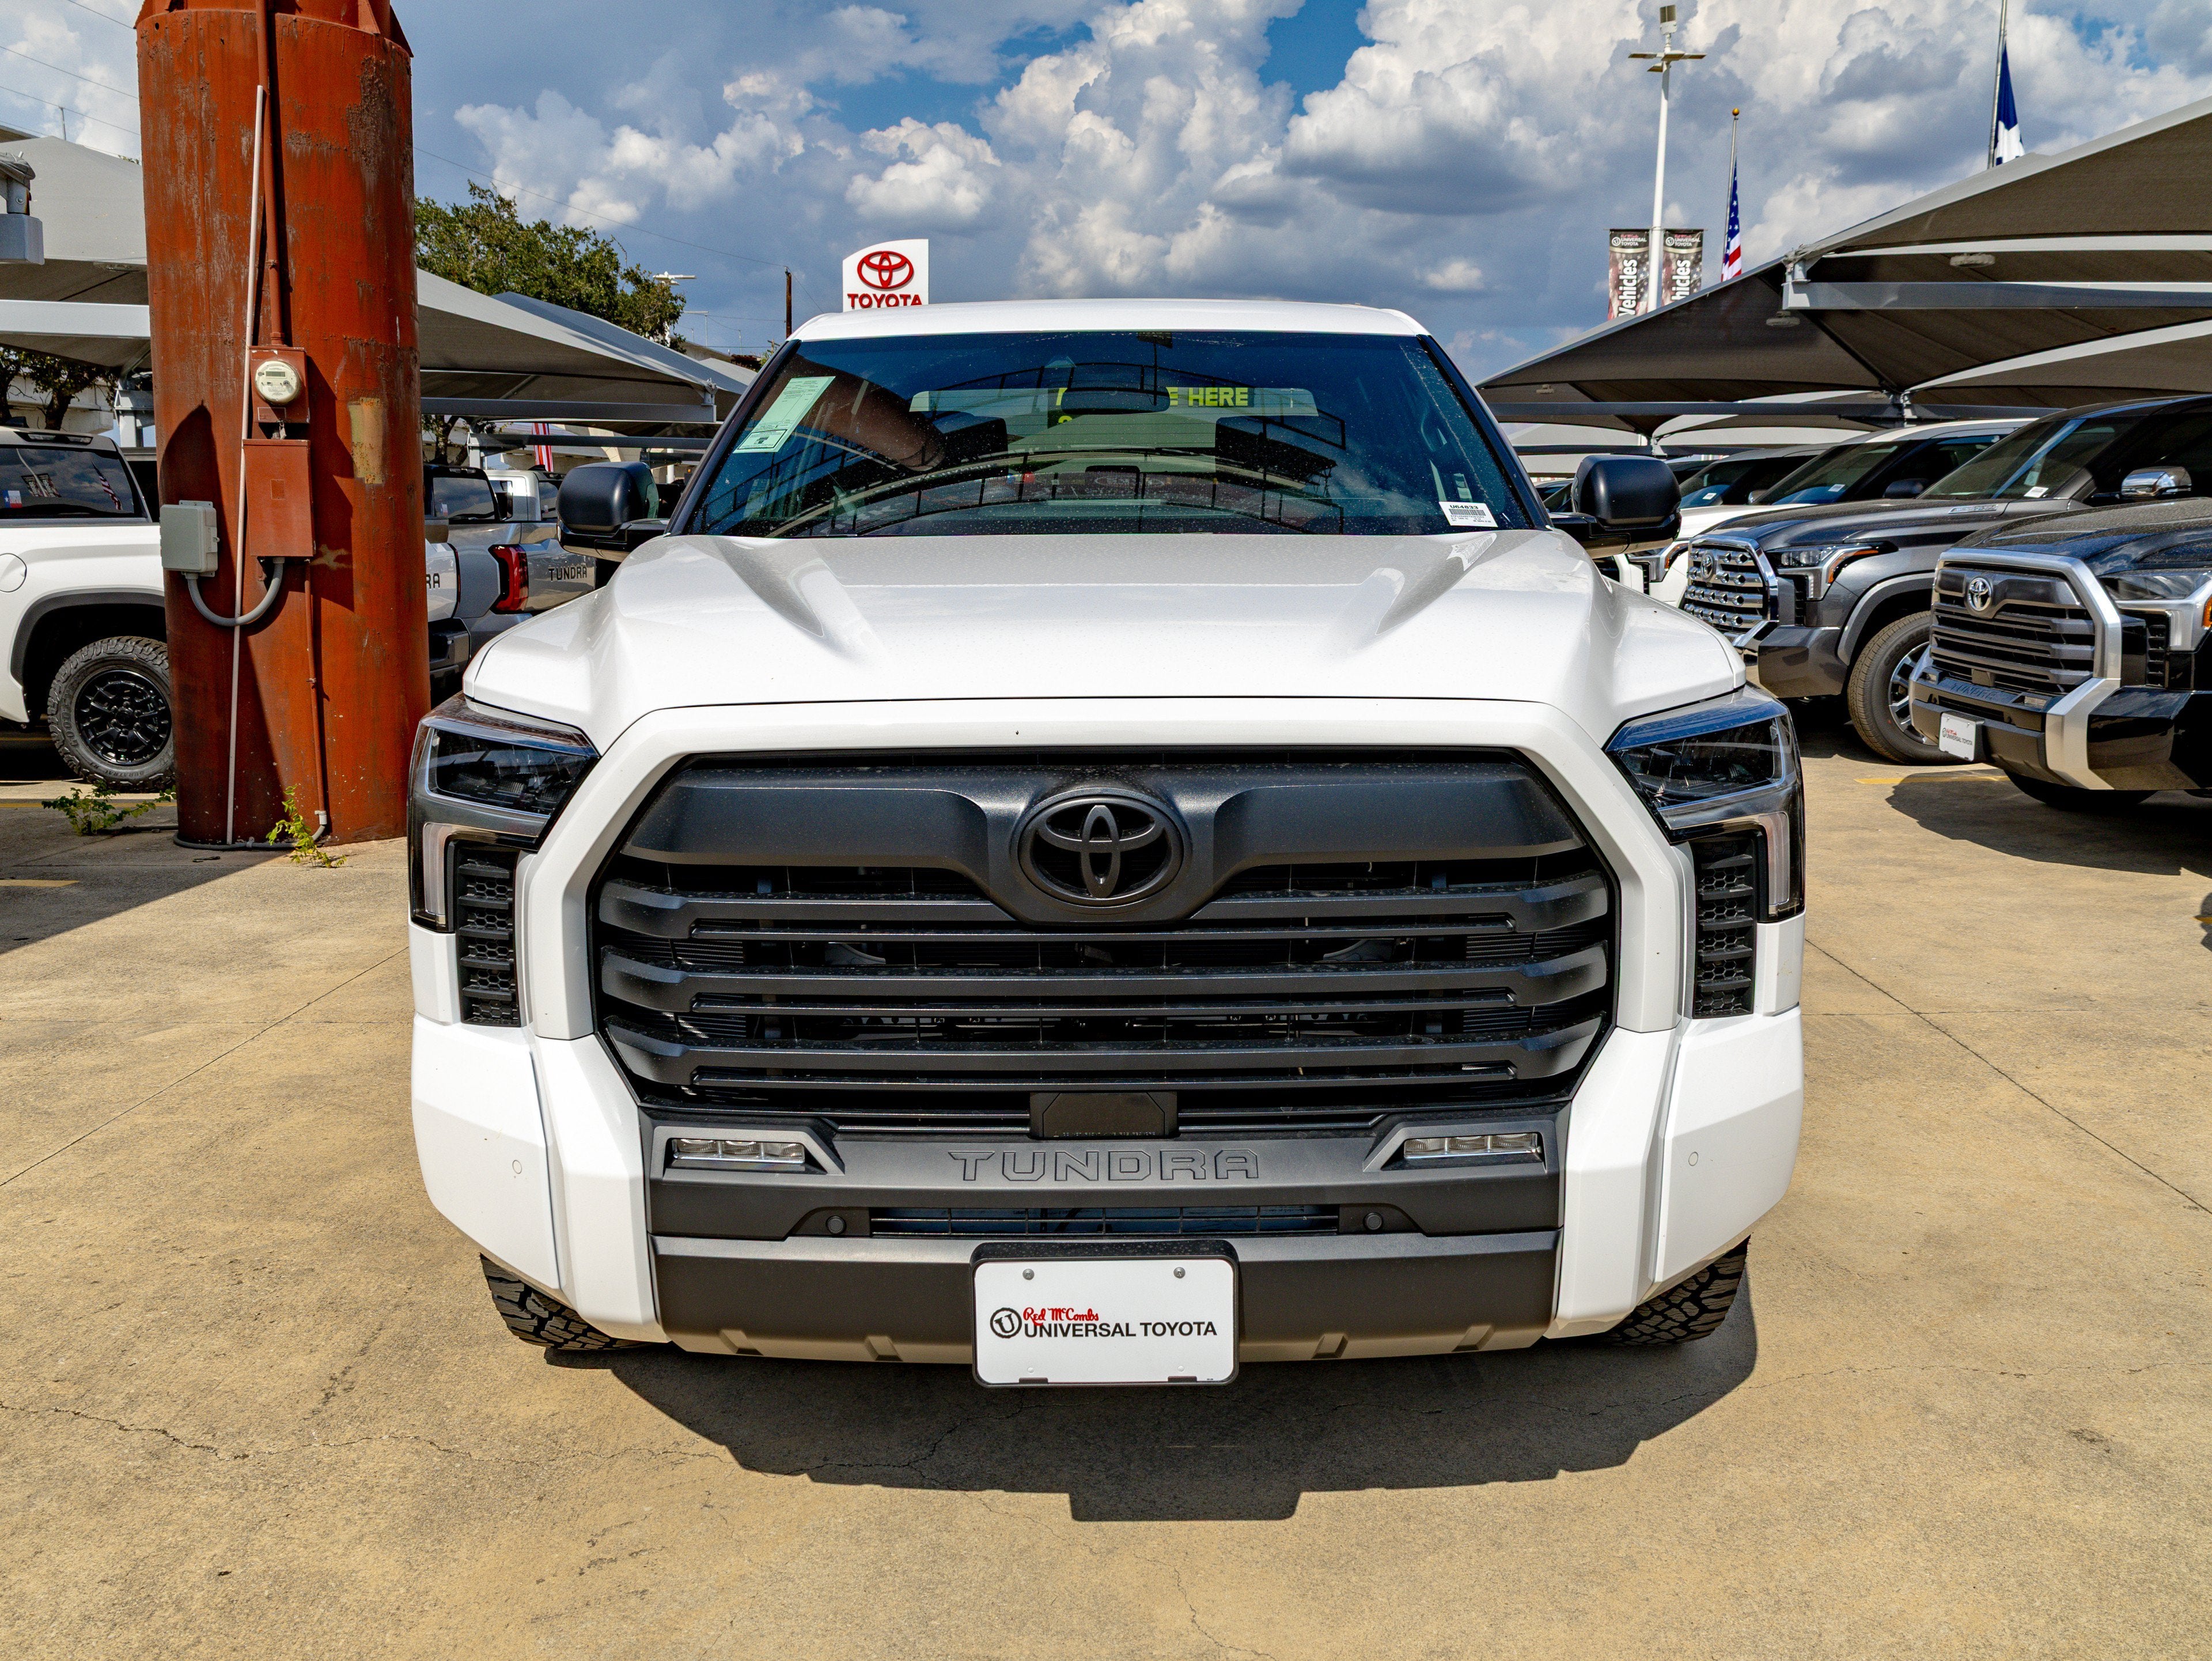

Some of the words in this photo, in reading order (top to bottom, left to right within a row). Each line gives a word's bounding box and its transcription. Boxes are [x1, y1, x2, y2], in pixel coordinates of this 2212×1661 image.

[1671, 259, 1691, 300] hicles
[847, 293, 922, 309] TOYOTA
[1188, 387, 1248, 406] HERE
[548, 566, 587, 581] TUNDRA
[948, 1149, 1259, 1181] TUNDRA
[1023, 1307, 1046, 1326] Red
[1047, 1307, 1099, 1321] McCombs
[1024, 1322, 1136, 1338] UNIVERSAL
[1139, 1321, 1218, 1337] TOYOTA
